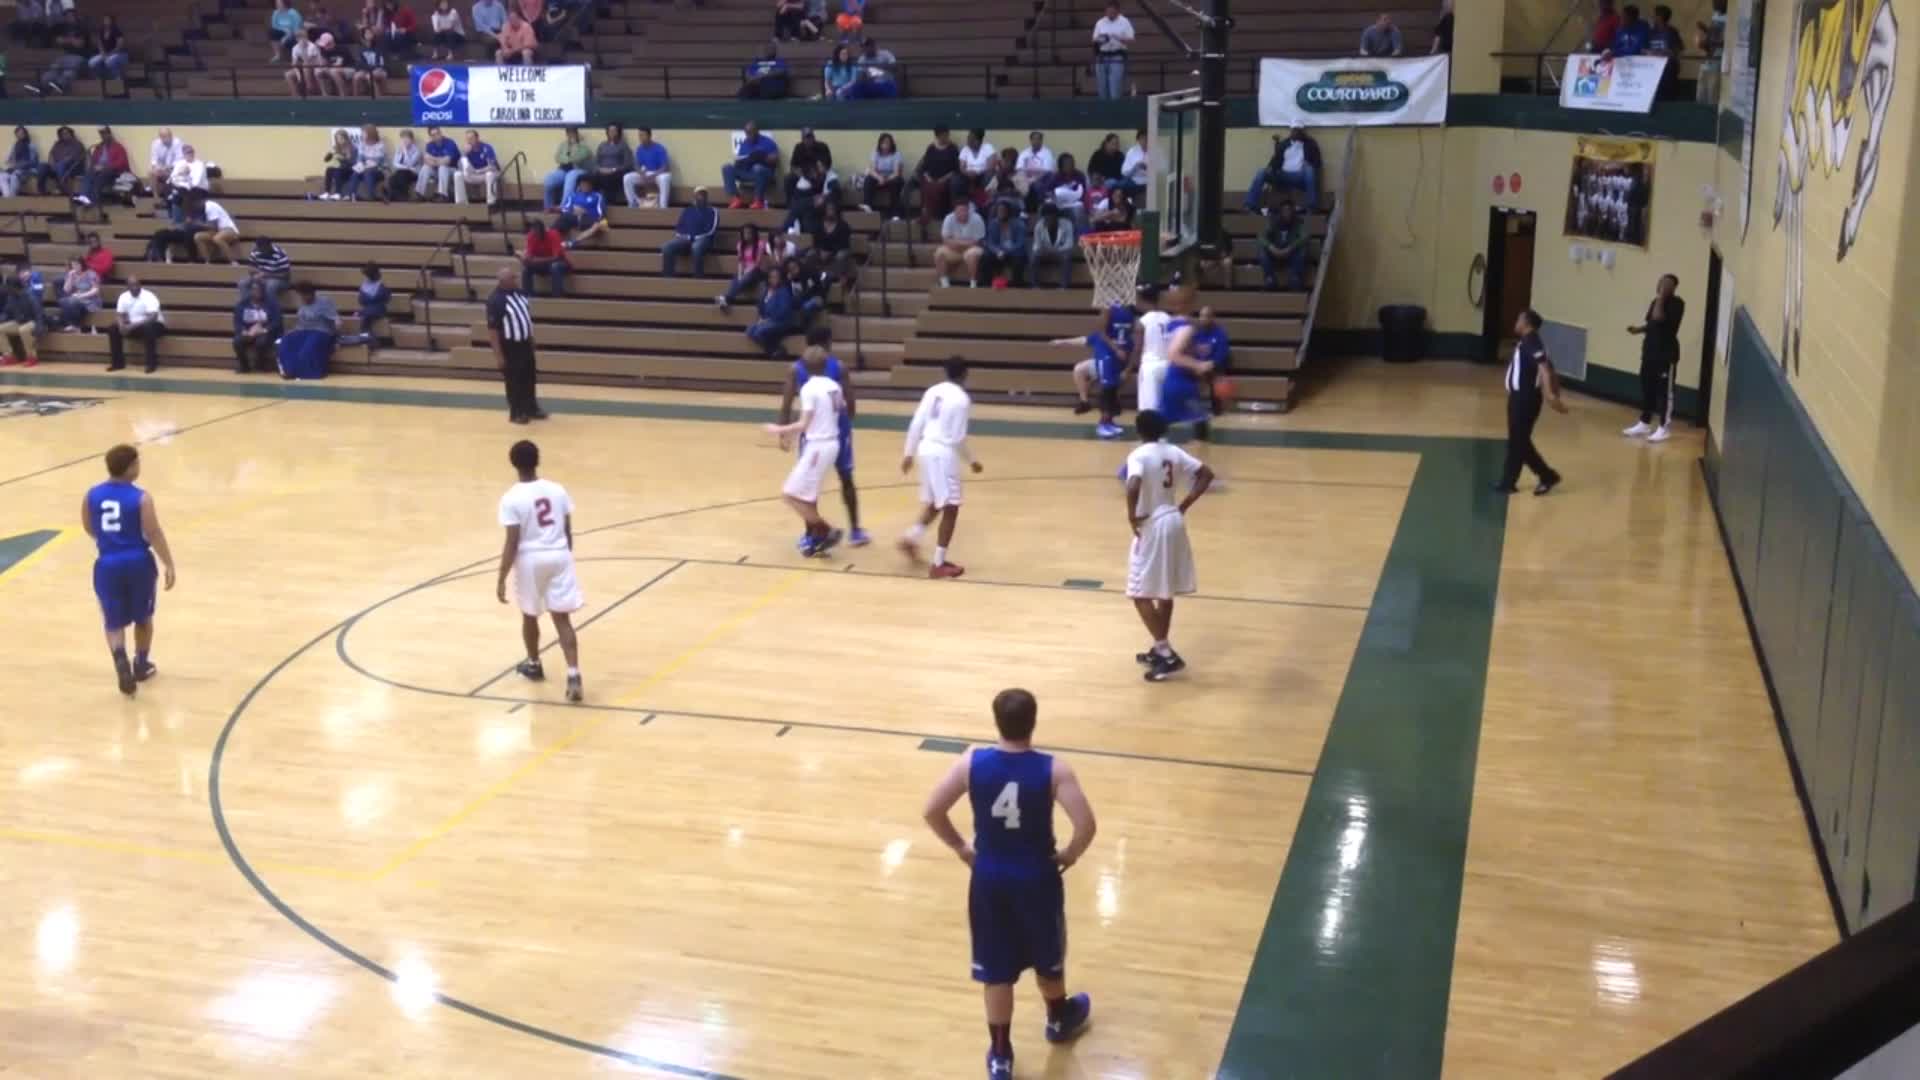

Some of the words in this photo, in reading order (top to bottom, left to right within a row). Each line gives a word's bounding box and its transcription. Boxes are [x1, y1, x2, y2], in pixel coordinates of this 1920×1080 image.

[499, 67, 546, 82] WELCOME
[505, 89, 517, 102] TO
[521, 89, 535, 102] THE
[1307, 86, 1400, 101] COURTYARD
[422, 110, 452, 121] pepsi
[490, 107, 531, 121] CAROLINA
[534, 108, 564, 121] CLASSIC
[1162, 460, 1173, 489] 3
[101, 500, 121, 532] 2
[535, 498, 555, 528] 2
[992, 781, 1021, 829] 4
